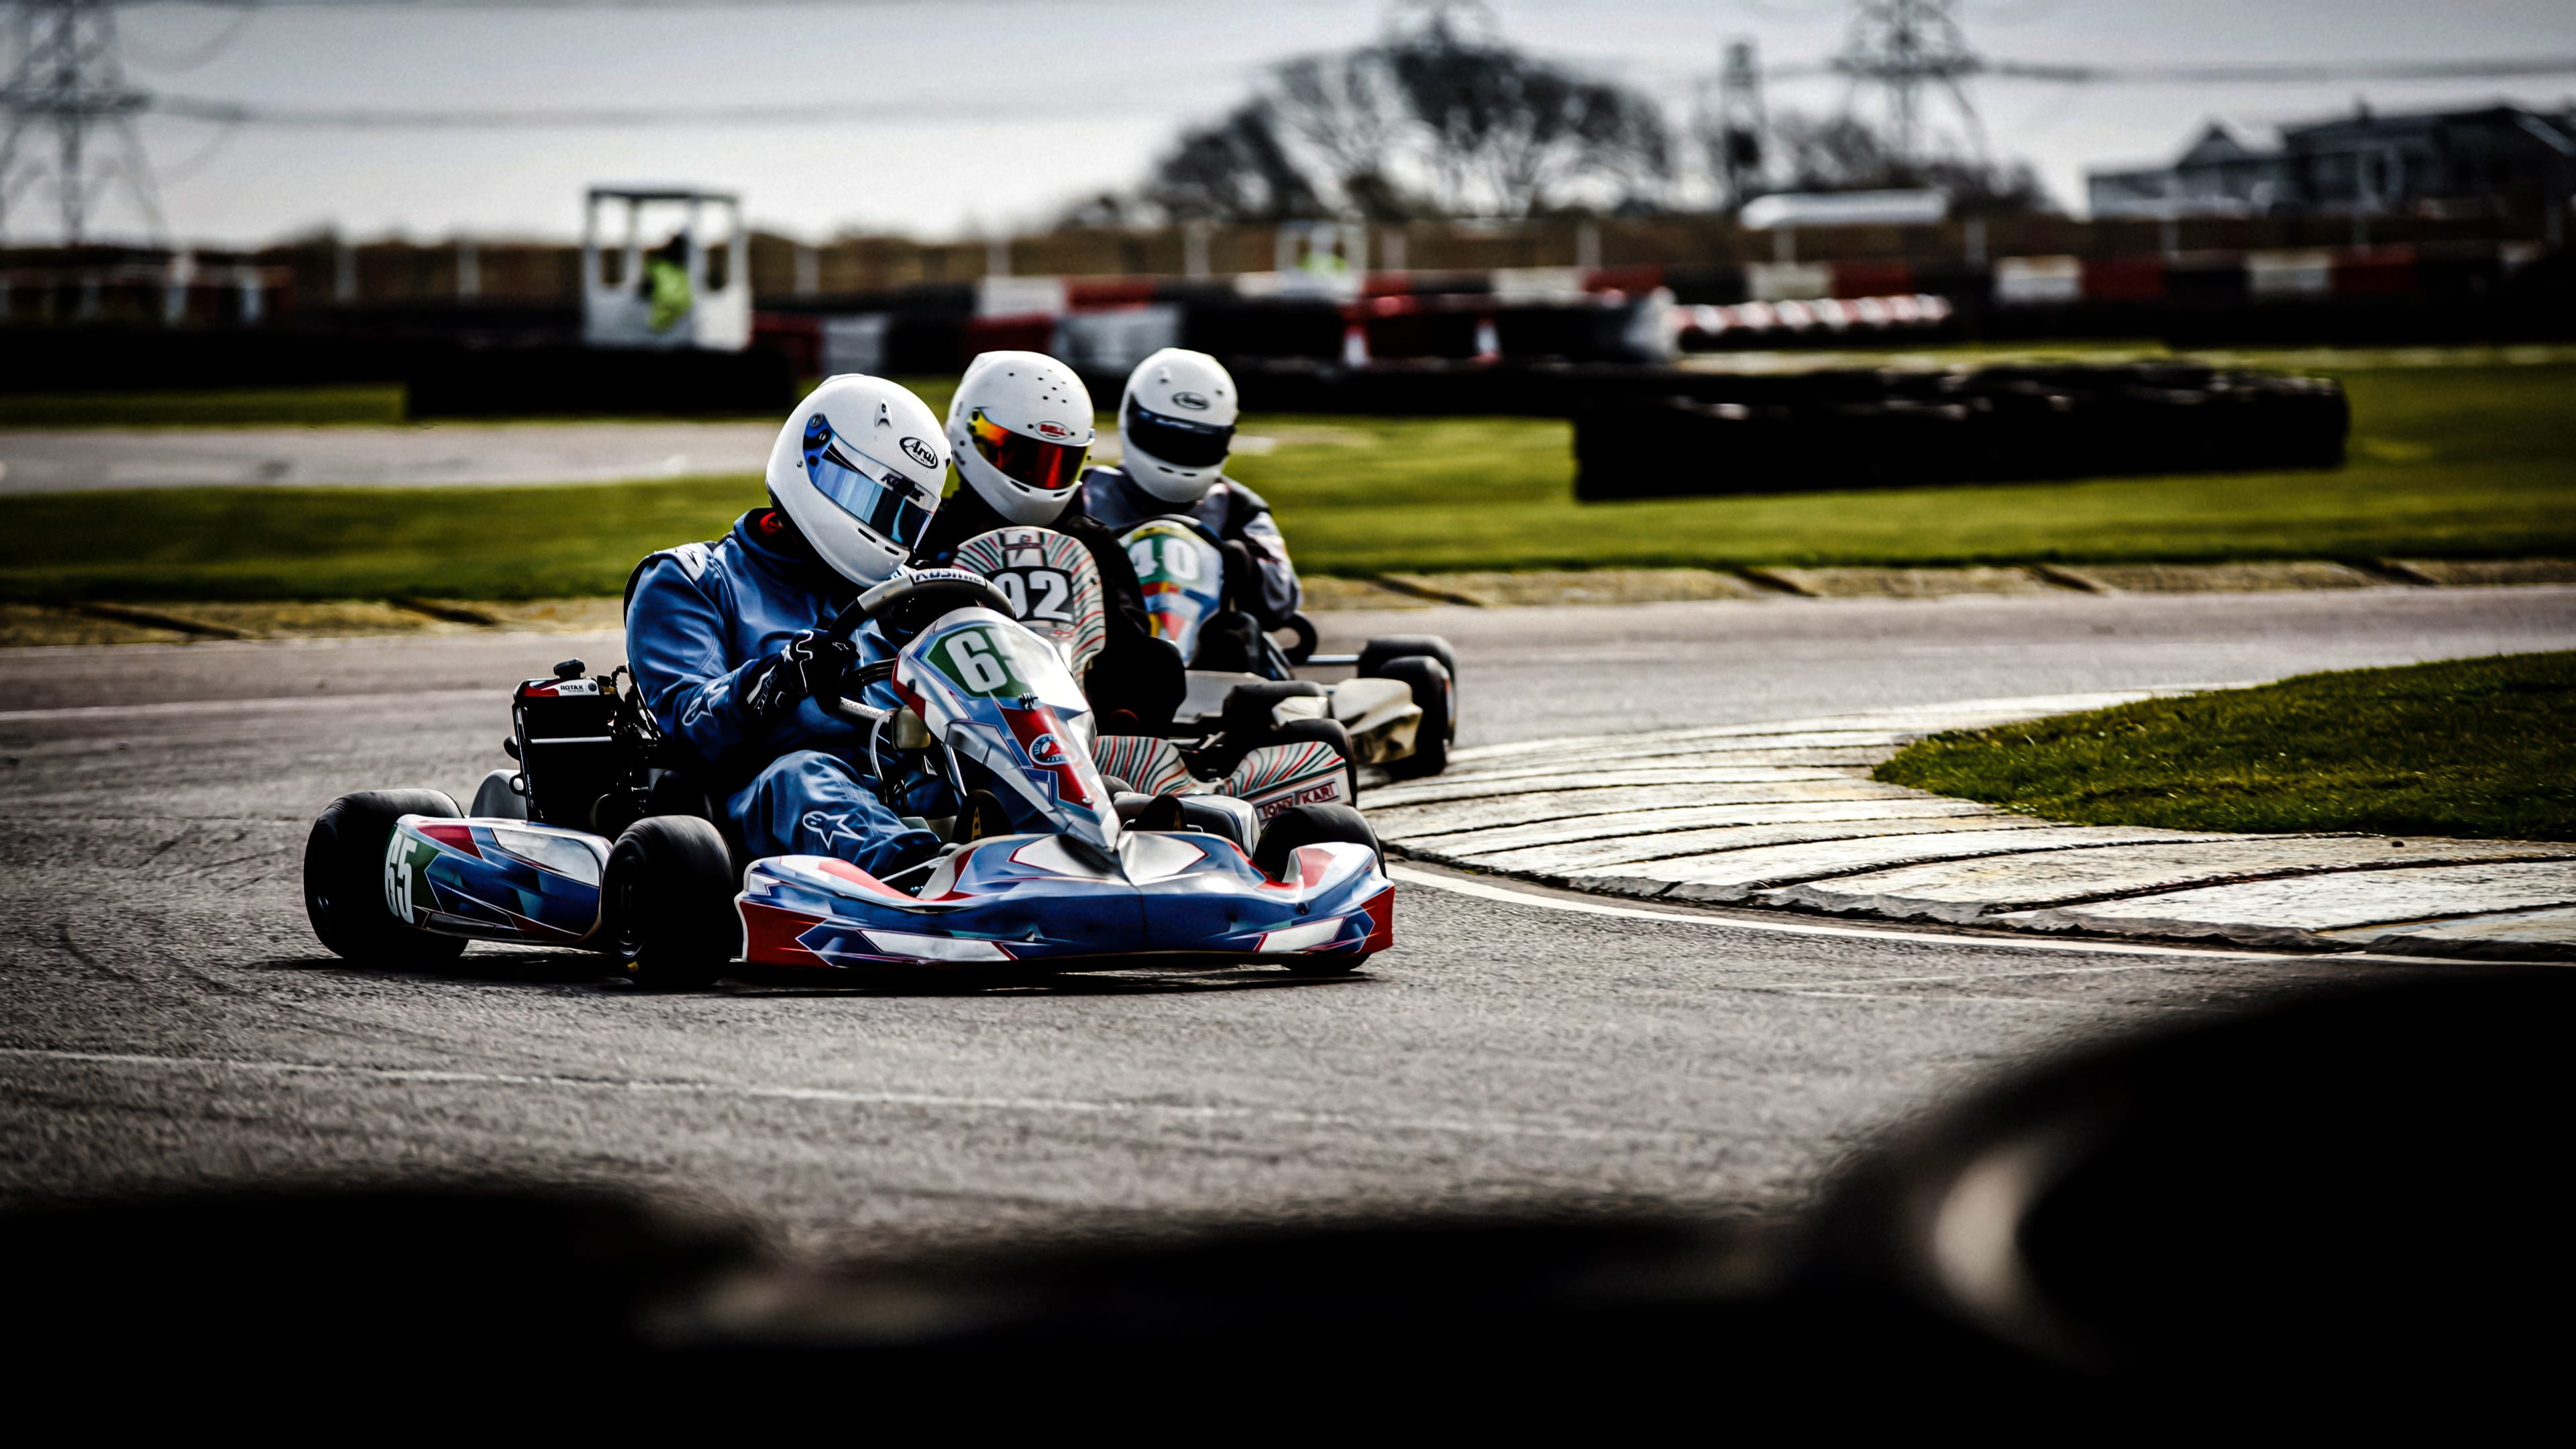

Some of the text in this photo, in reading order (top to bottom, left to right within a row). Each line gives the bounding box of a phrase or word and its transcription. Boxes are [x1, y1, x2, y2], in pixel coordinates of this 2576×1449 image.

[904, 440, 936, 464] Arai
[1128, 537, 1200, 580] 40
[991, 570, 1073, 621] 92
[1300, 781, 1339, 804] KART
[384, 830, 418, 924] 65
